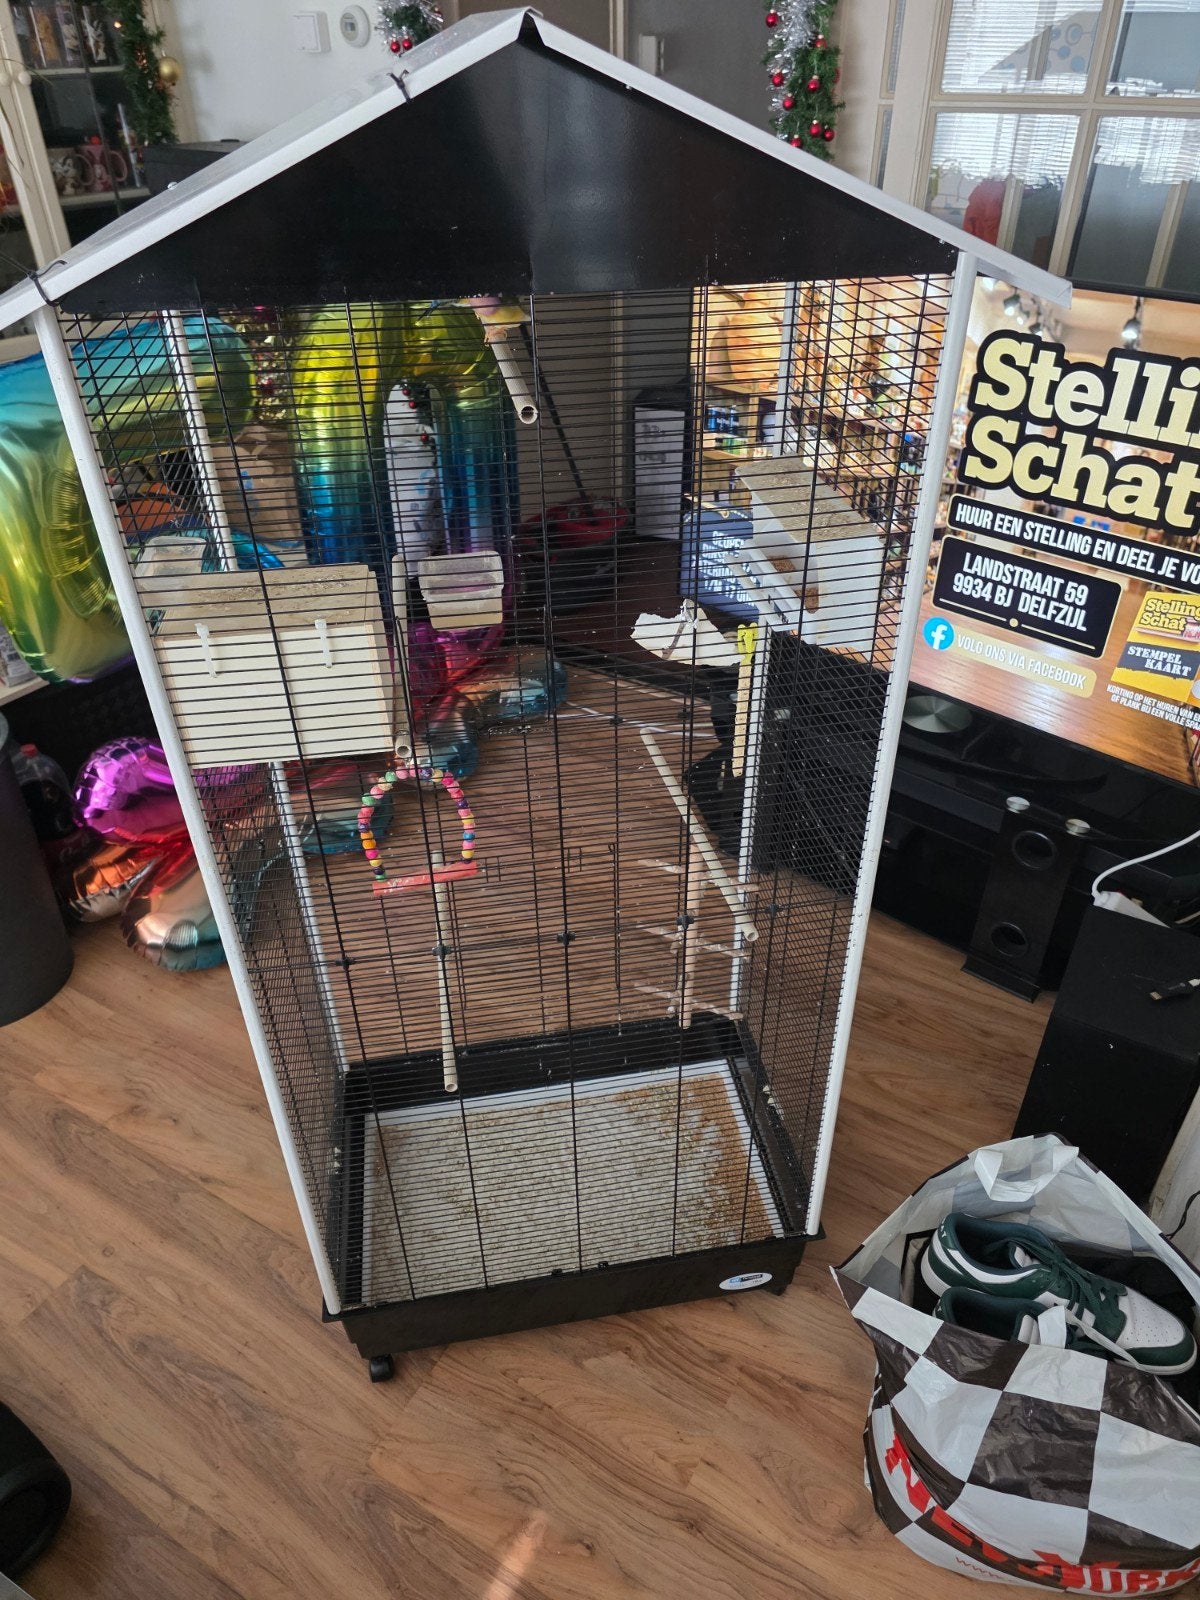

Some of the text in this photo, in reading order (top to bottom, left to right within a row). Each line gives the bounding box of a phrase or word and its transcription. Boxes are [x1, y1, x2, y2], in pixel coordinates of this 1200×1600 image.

[975, 338, 1200, 448] Stelli
[965, 415, 1200, 528] Schat
[955, 503, 1200, 585] HUUR EEN STELLING EN DEEL JE VO
[952, 573, 1087, 632] 9934 BJ DELFZIJL
[962, 552, 1089, 606] LANDSTRAAT 59
[1140, 611, 1187, 632] Schat
[957, 634, 1087, 690] VOLG ONS VIA FACEBOOK
[1127, 645, 1182, 665] STEMPEL
[1144, 658, 1192, 677] KAART
[1106, 684, 1134, 699] KORTING
[1133, 693, 1144, 701] OP
[1143, 696, 1158, 706] HET
[1156, 701, 1180, 715] HUREN
[1180, 707, 1194, 719] VAN
[1110, 694, 1120, 703] OF
[1120, 697, 1141, 710] PLANK
[1151, 707, 1165, 718] EEN
[1164, 711, 1185, 726] VOLLE
[1185, 719, 1200, 731] SPA
